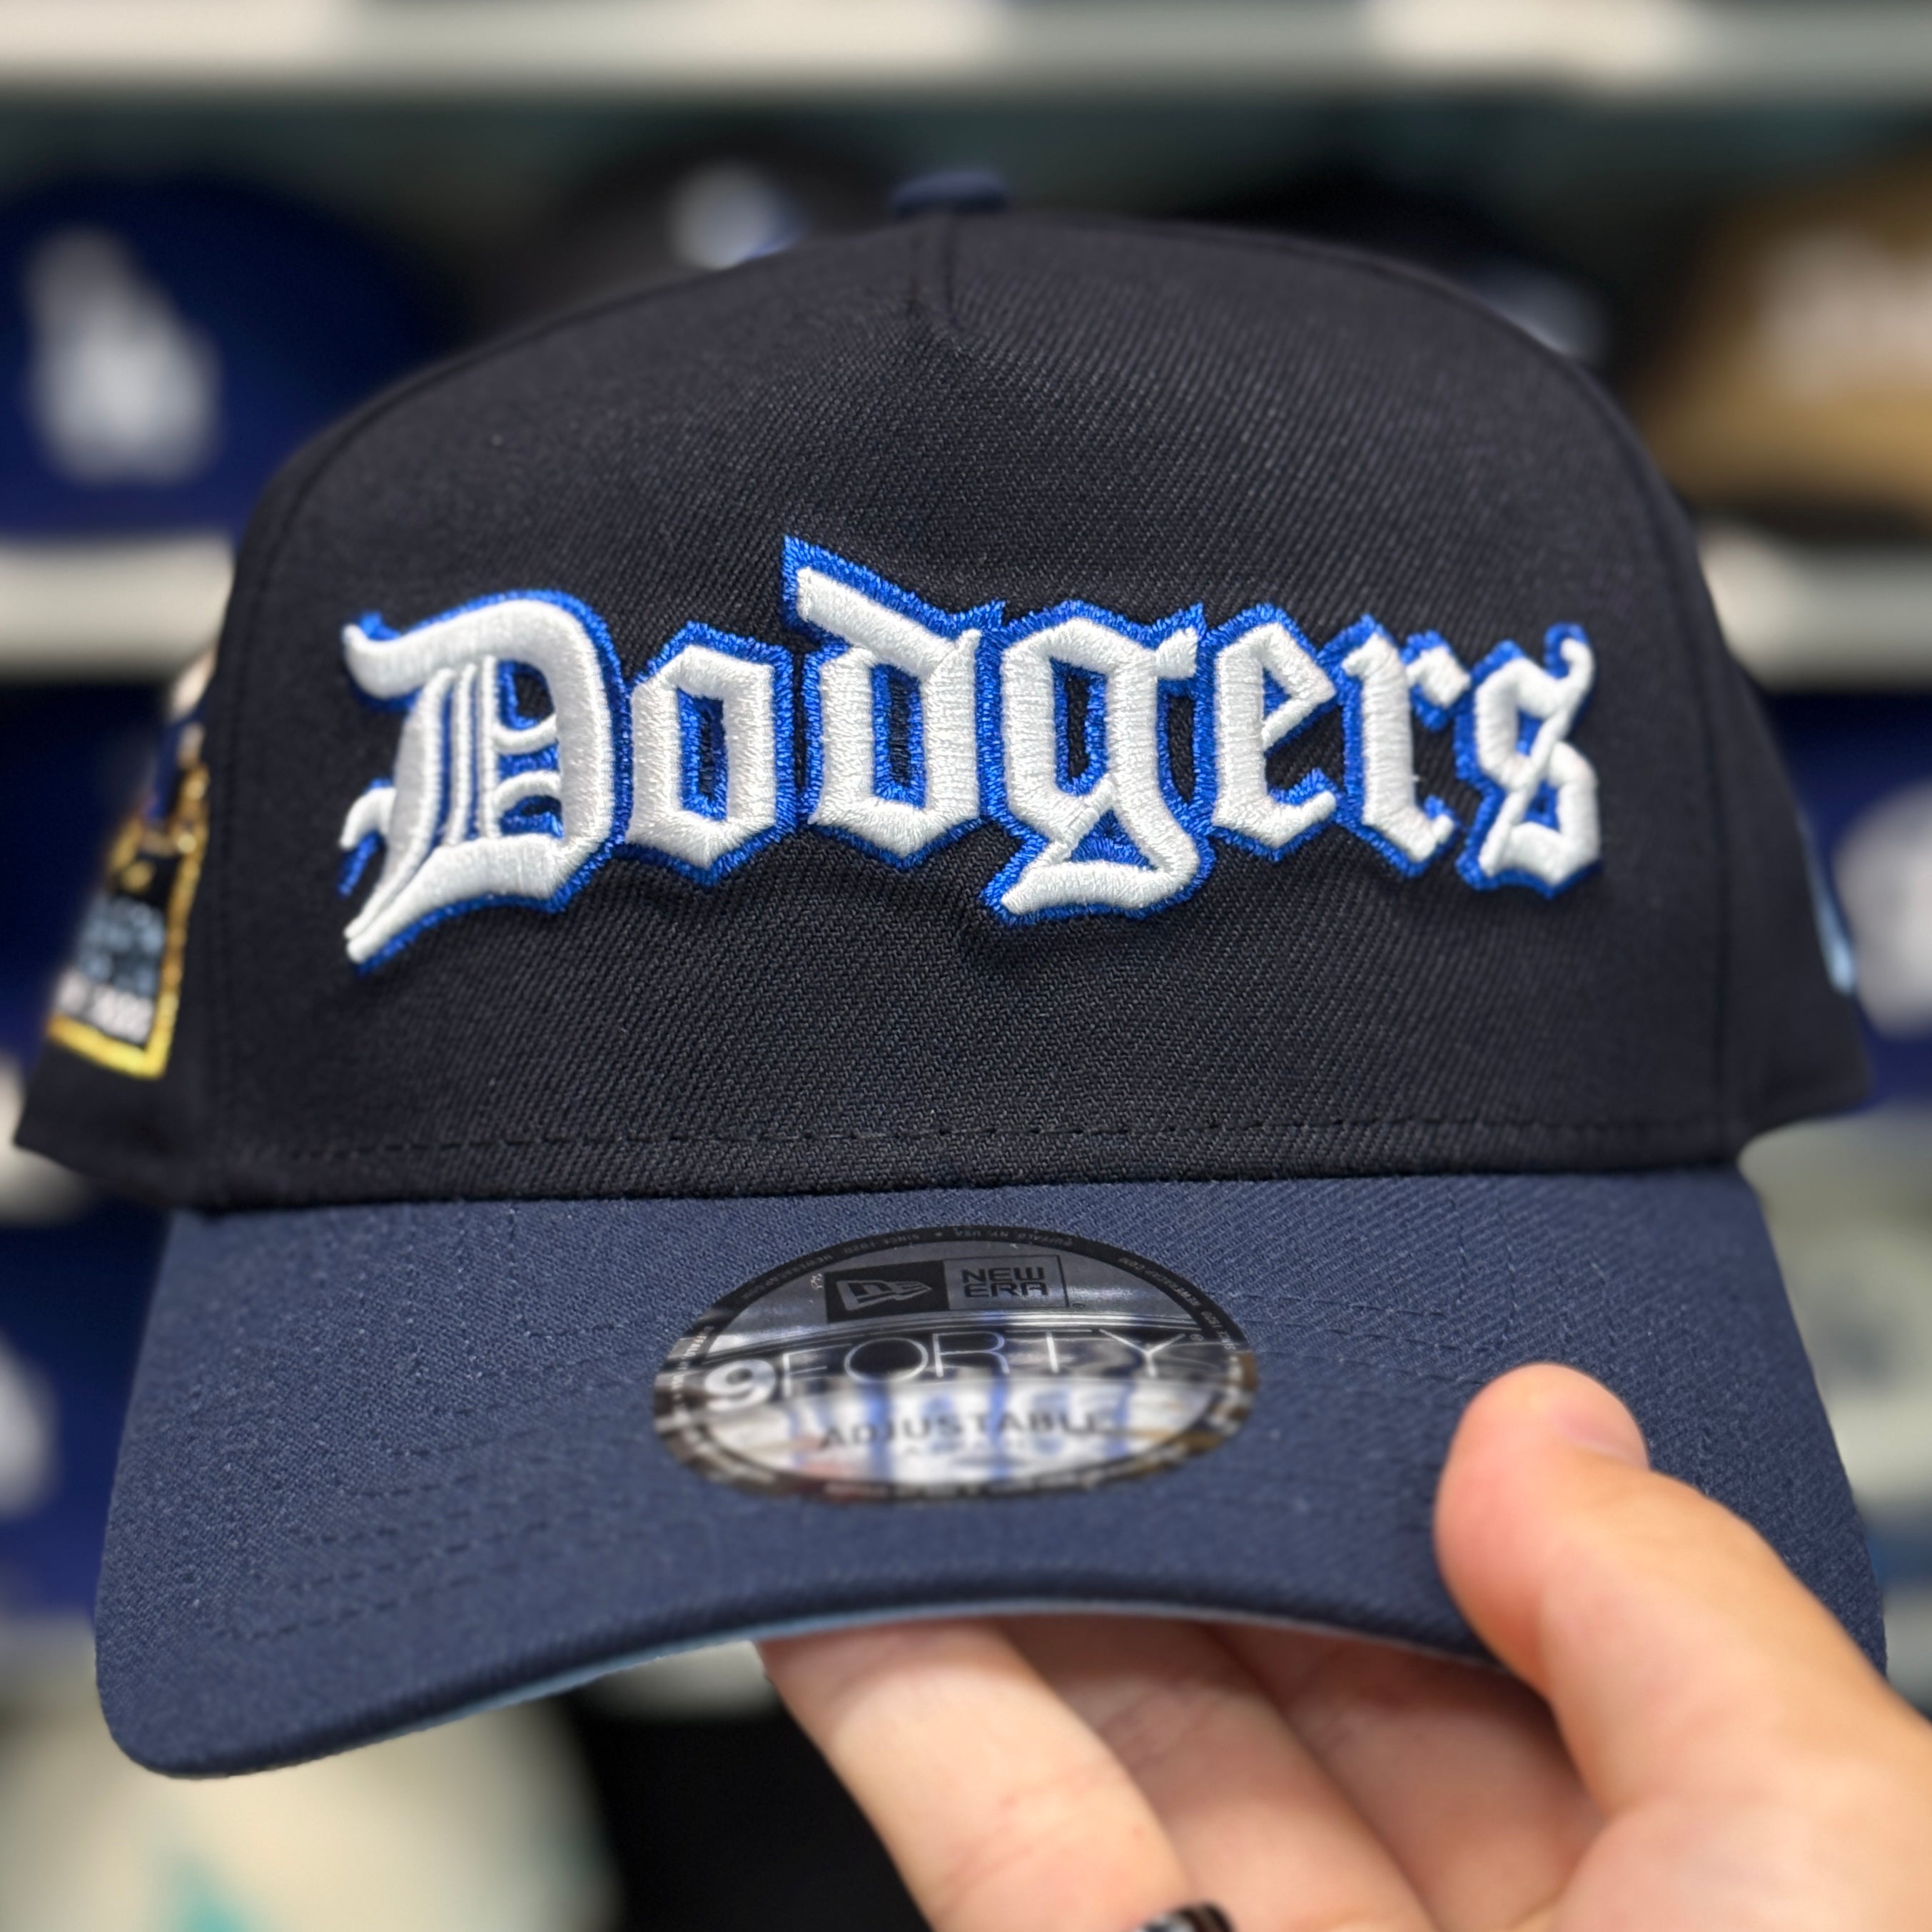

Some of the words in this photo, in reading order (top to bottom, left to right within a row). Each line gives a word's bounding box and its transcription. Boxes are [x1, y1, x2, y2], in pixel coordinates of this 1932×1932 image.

[340, 536, 1599, 970] Dodgers
[961, 1266, 1046, 1283] NEW
[964, 1282, 1050, 1298] ERA
[704, 1327, 1186, 1412] 9FORTY
[821, 1411, 1108, 1452] ADJUSTABLE
